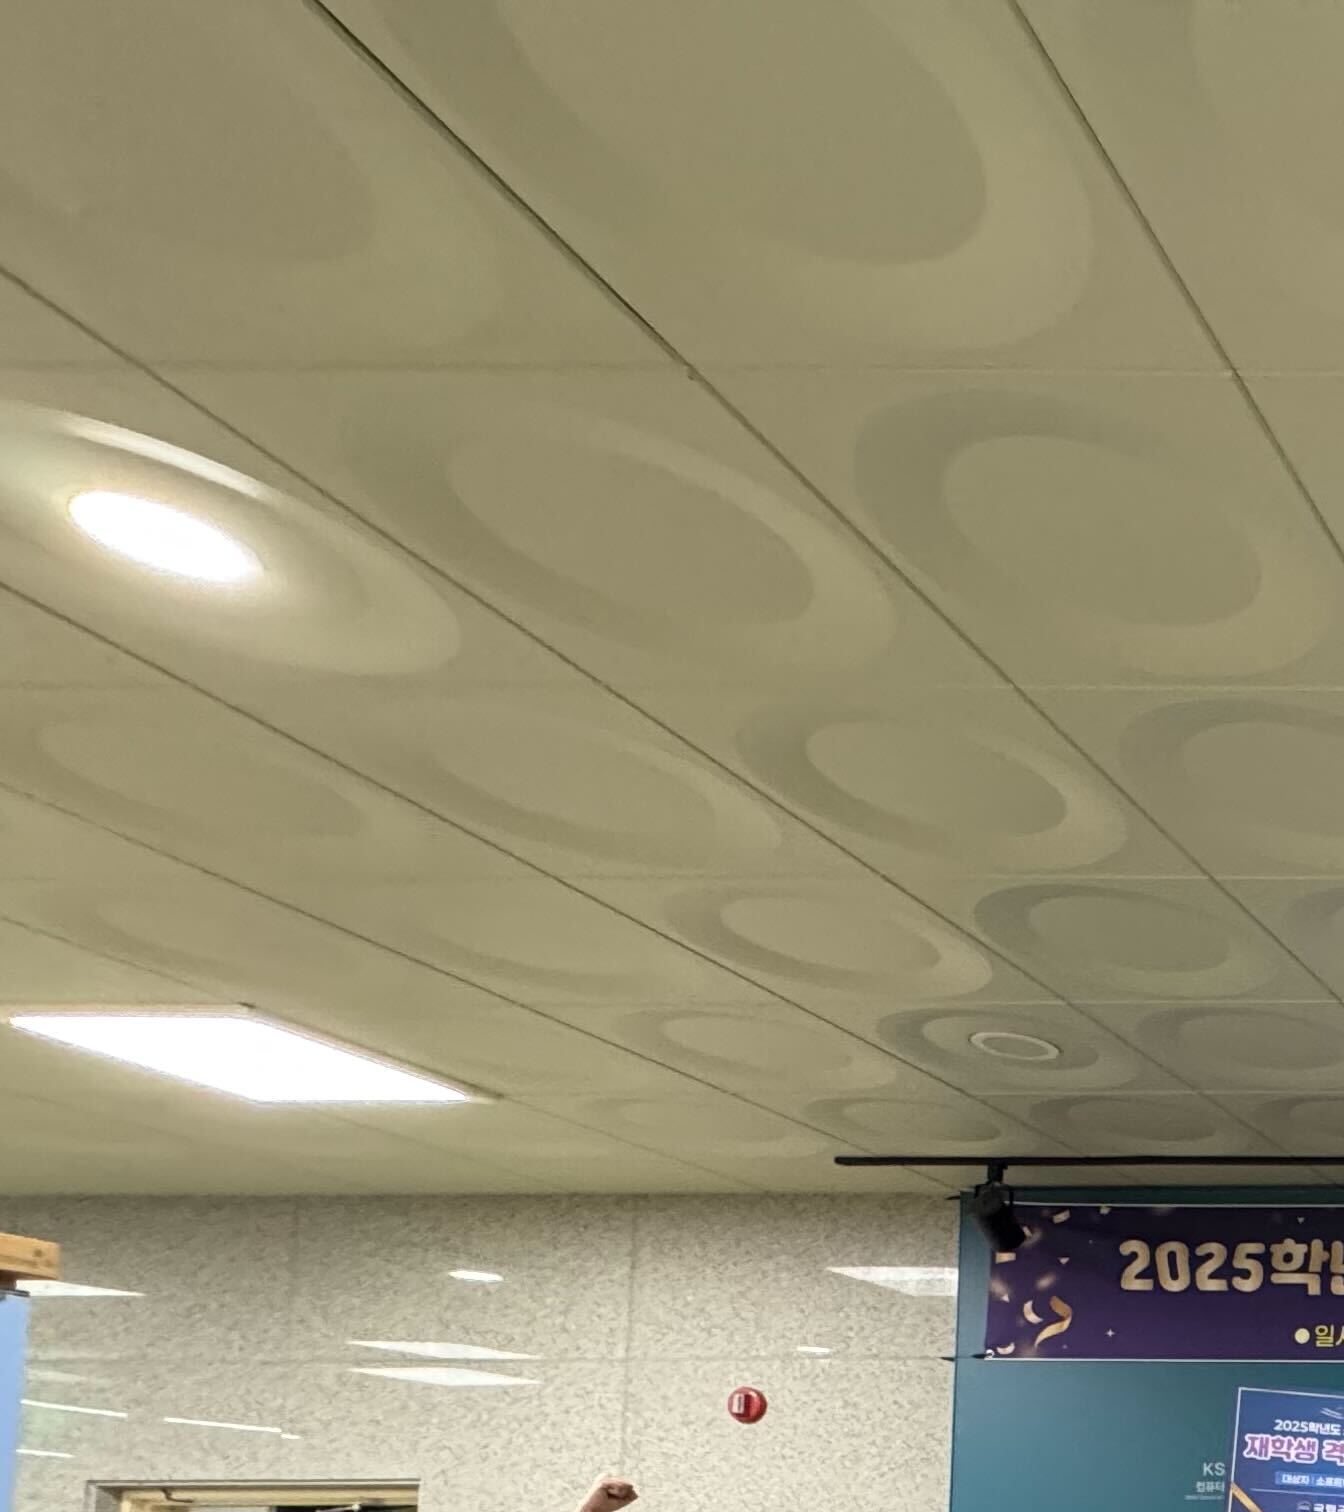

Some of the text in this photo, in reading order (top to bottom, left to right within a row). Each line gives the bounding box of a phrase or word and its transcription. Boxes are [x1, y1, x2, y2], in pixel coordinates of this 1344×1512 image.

[1273, 1419, 1342, 1436] 2025학년도
[1243, 1434, 1319, 1463] 재학생
[1203, 1462, 1226, 1476] KS
